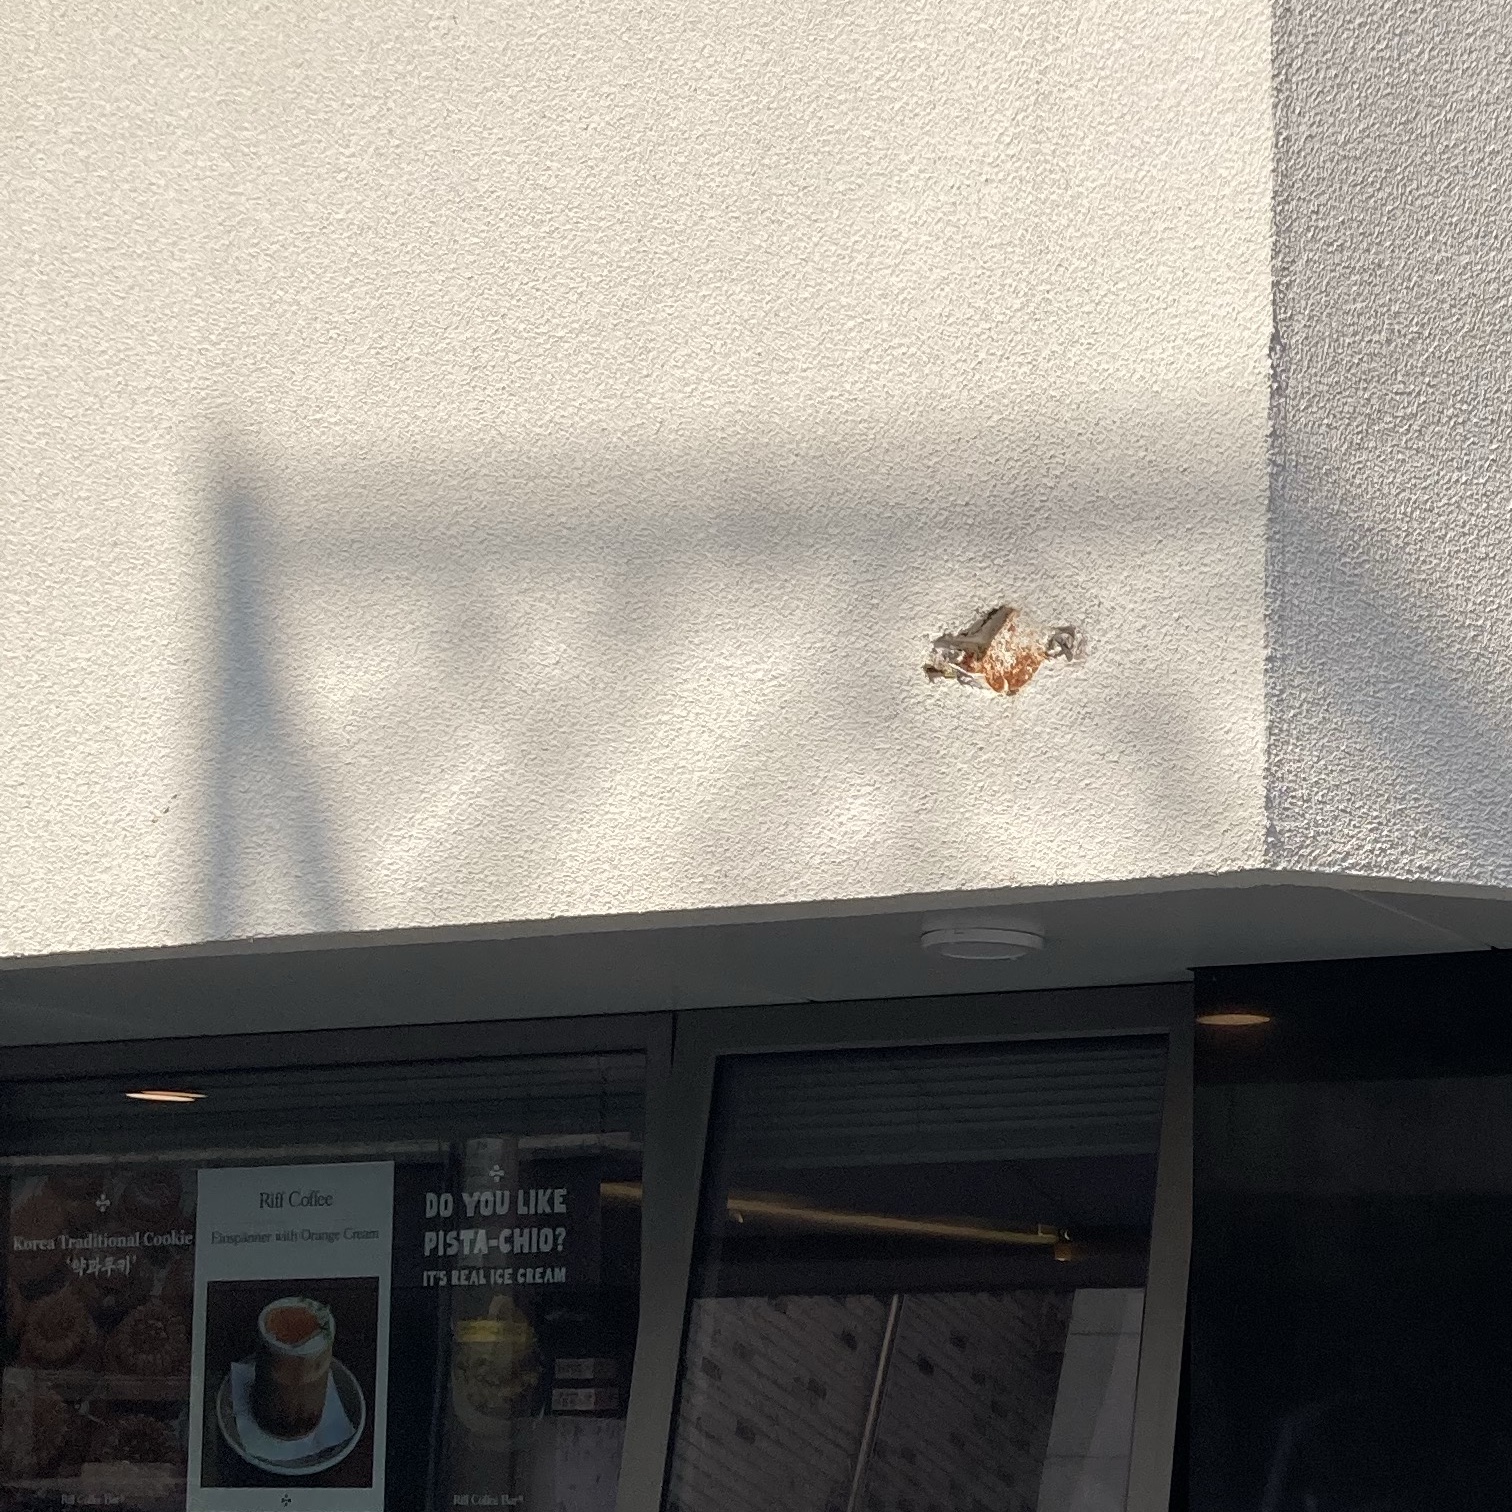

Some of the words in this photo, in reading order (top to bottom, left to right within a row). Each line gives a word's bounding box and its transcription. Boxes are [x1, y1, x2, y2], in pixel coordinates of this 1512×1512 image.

[259, 1192, 284, 1209] Riff
[289, 1190, 334, 1207] Coffee
[425, 1192, 454, 1218] DO
[461, 1190, 510, 1217] YOU
[517, 1187, 568, 1215] LIKE
[13, 1235, 56, 1251] Korea
[60, 1231, 139, 1249] Traditional
[143, 1229, 193, 1246] Cookie
[301, 1228, 340, 1244] Orange
[343, 1227, 379, 1239] Cream
[423, 1227, 566, 1257] PISTA-CHIO?
[422, 1270, 448, 1287] IT'S
[451, 1268, 487, 1286] REAL
[490, 1267, 513, 1285] ICE
[517, 1266, 566, 1284] CREAM
